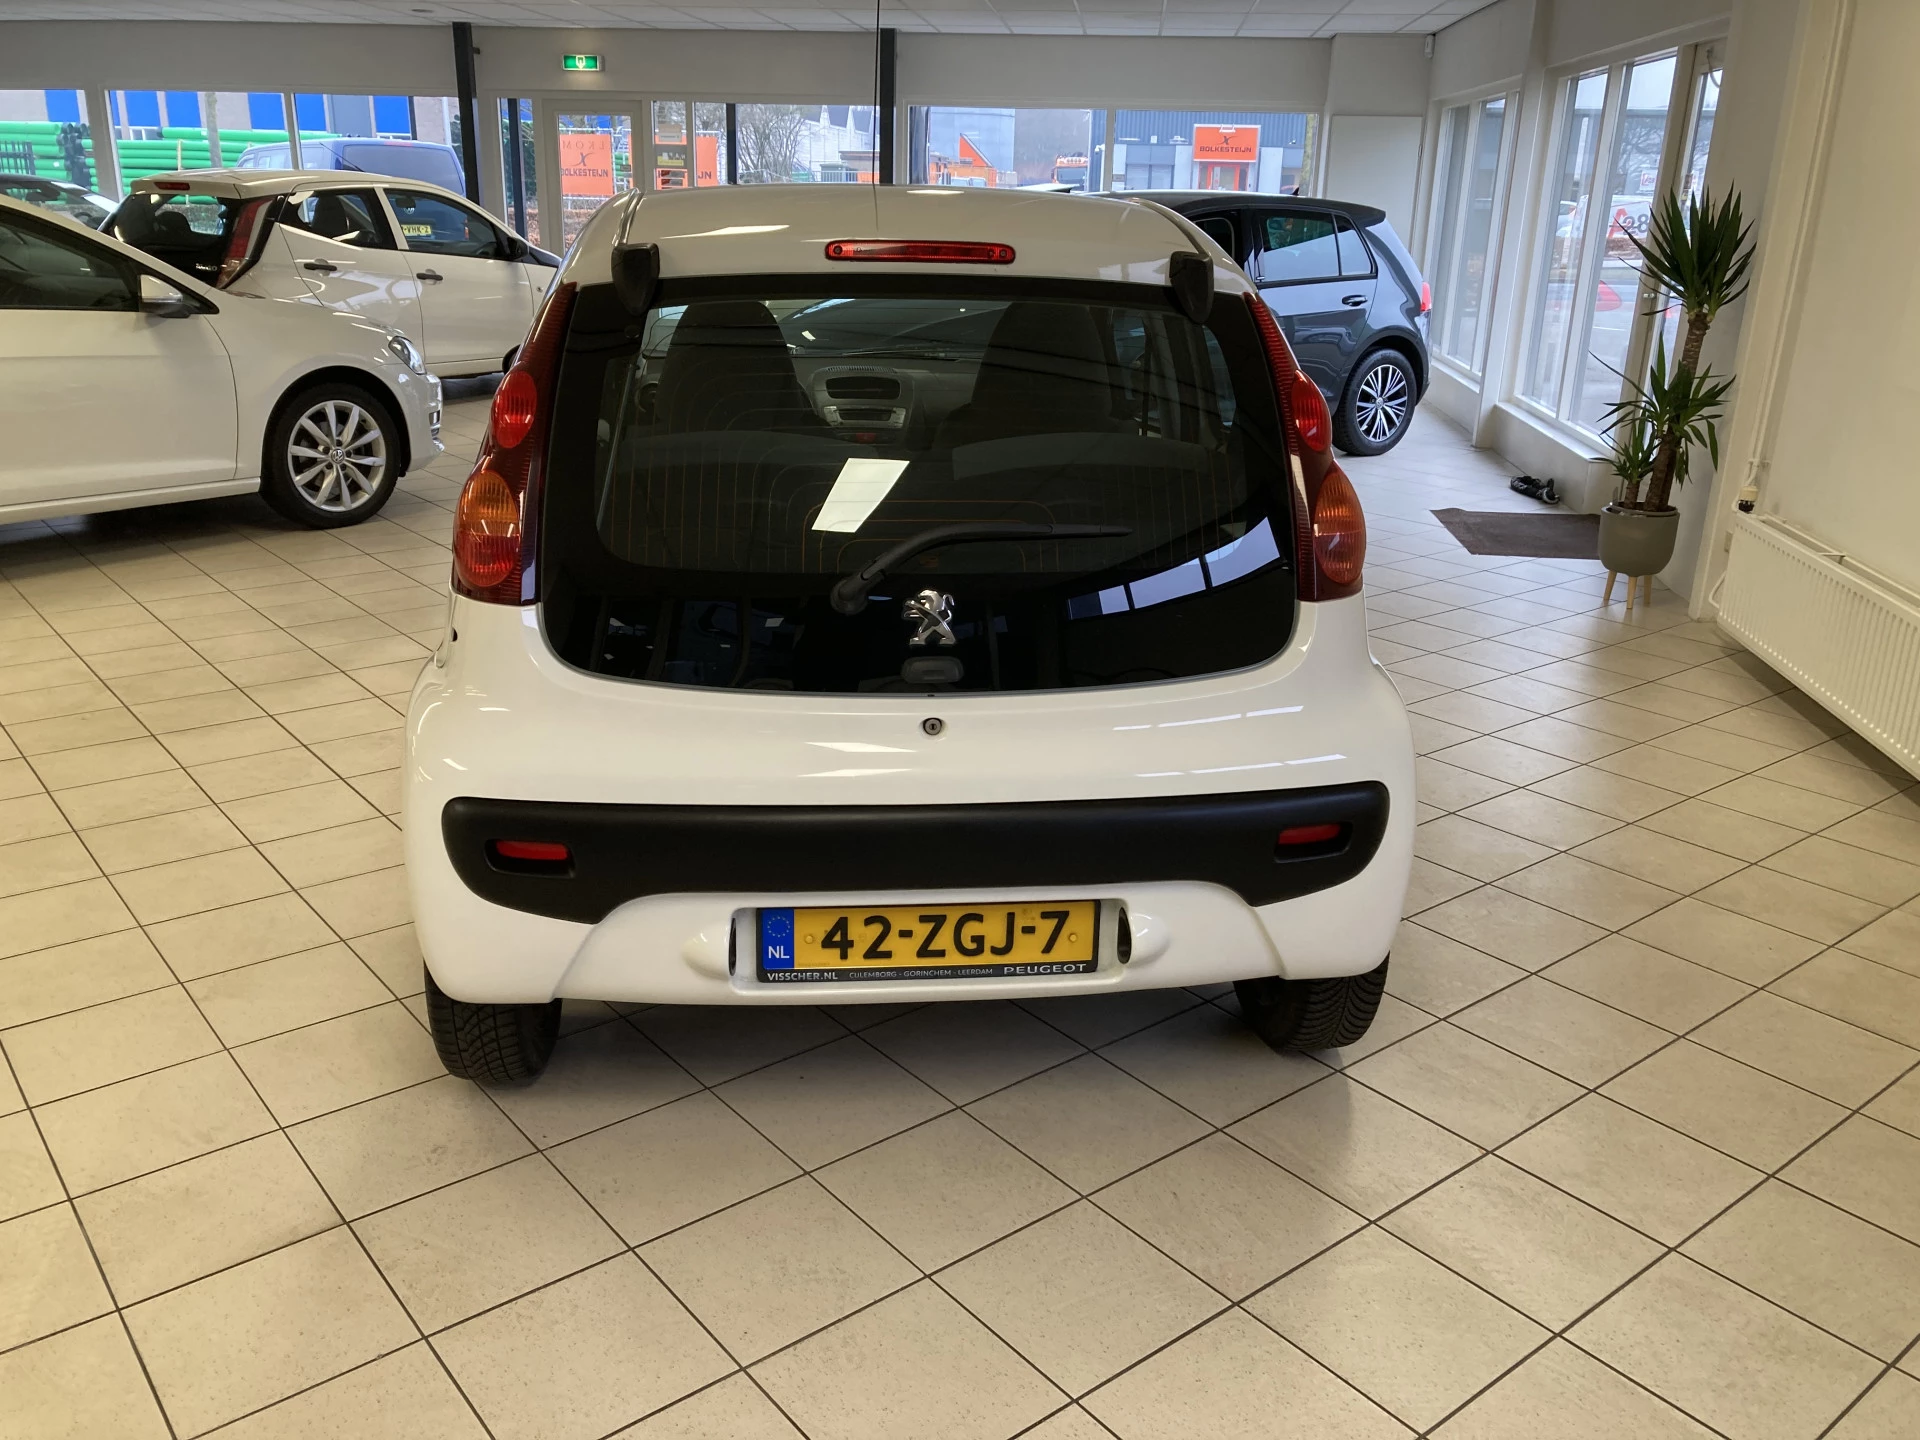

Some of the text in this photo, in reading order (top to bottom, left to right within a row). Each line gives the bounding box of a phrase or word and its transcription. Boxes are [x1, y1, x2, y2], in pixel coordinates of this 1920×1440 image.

[821, 910, 1070, 960] 42-ZGJ-7
[767, 945, 790, 959] NL
[767, 972, 839, 981] VISSCHER.NL
[849, 971, 898, 979] CULEMBORG
[903, 969, 952, 977] GORINCHEM
[957, 968, 993, 976] LEERDAM
[1003, 963, 1087, 975] PEUGEOT
